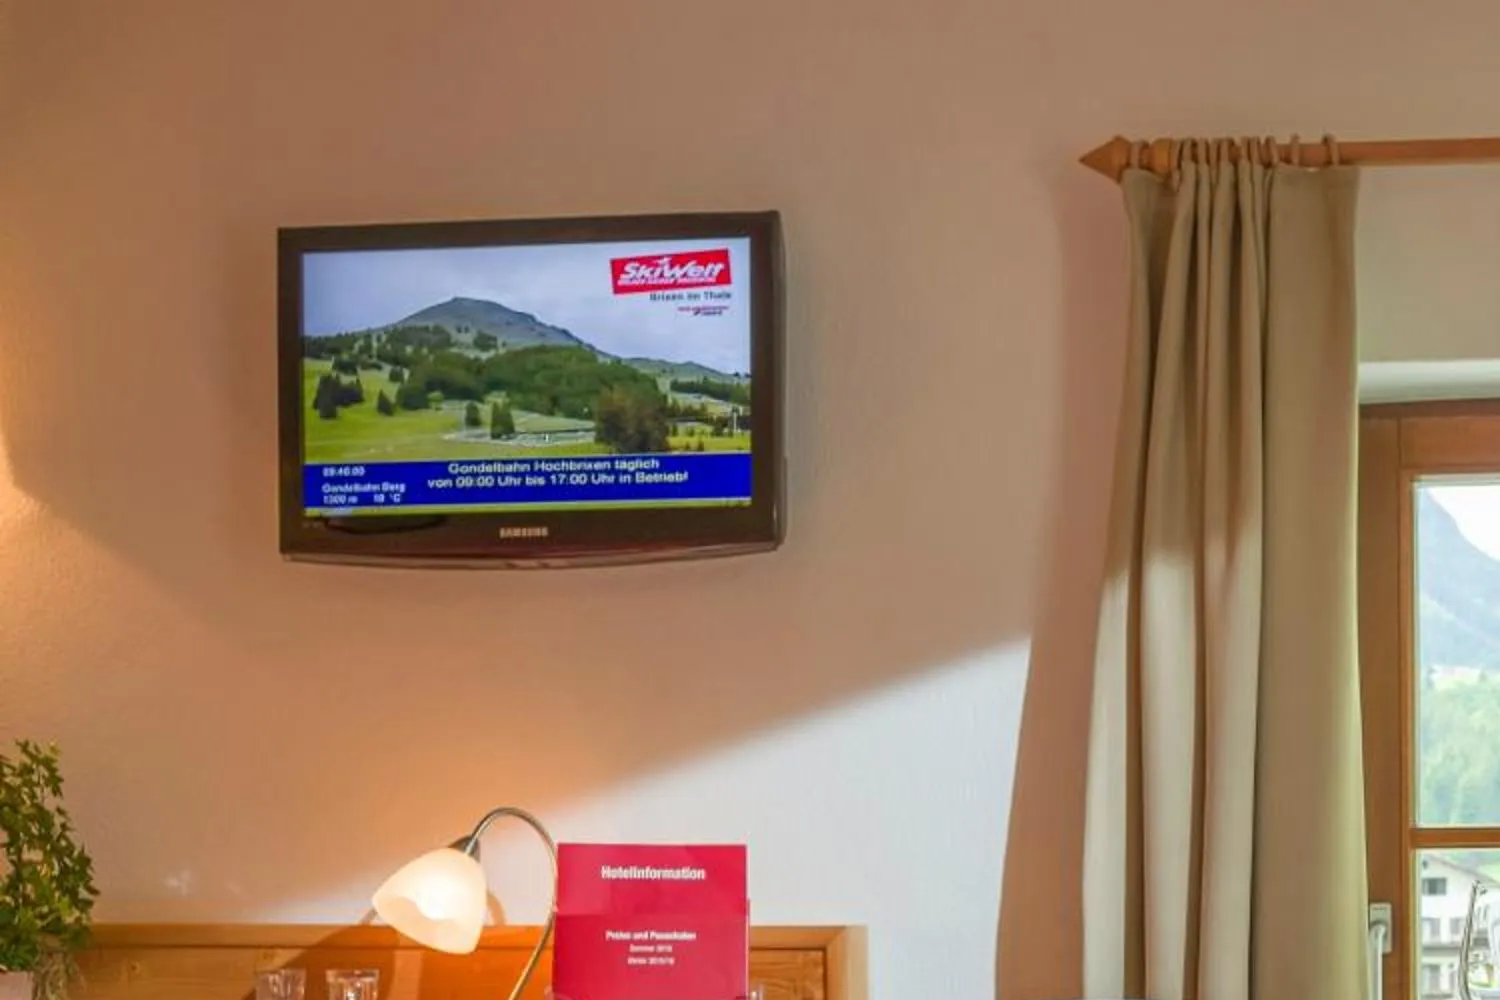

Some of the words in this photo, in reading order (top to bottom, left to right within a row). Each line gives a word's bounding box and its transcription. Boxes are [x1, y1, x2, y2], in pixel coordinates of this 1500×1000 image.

[621, 257, 724, 280] SkiWelt
[448, 461, 530, 473] Gondelbahn
[534, 460, 611, 471] Hochbrixen
[614, 458, 659, 470] täglich
[427, 478, 453, 489] von
[497, 474, 523, 487] Uhr
[525, 474, 546, 486] bis
[550, 472, 588, 485] 17:00
[590, 472, 616, 485] Uhr
[619, 472, 632, 483] in
[500, 527, 548, 537] SAMSUNG
[601, 866, 705, 880] Hotelinformation
